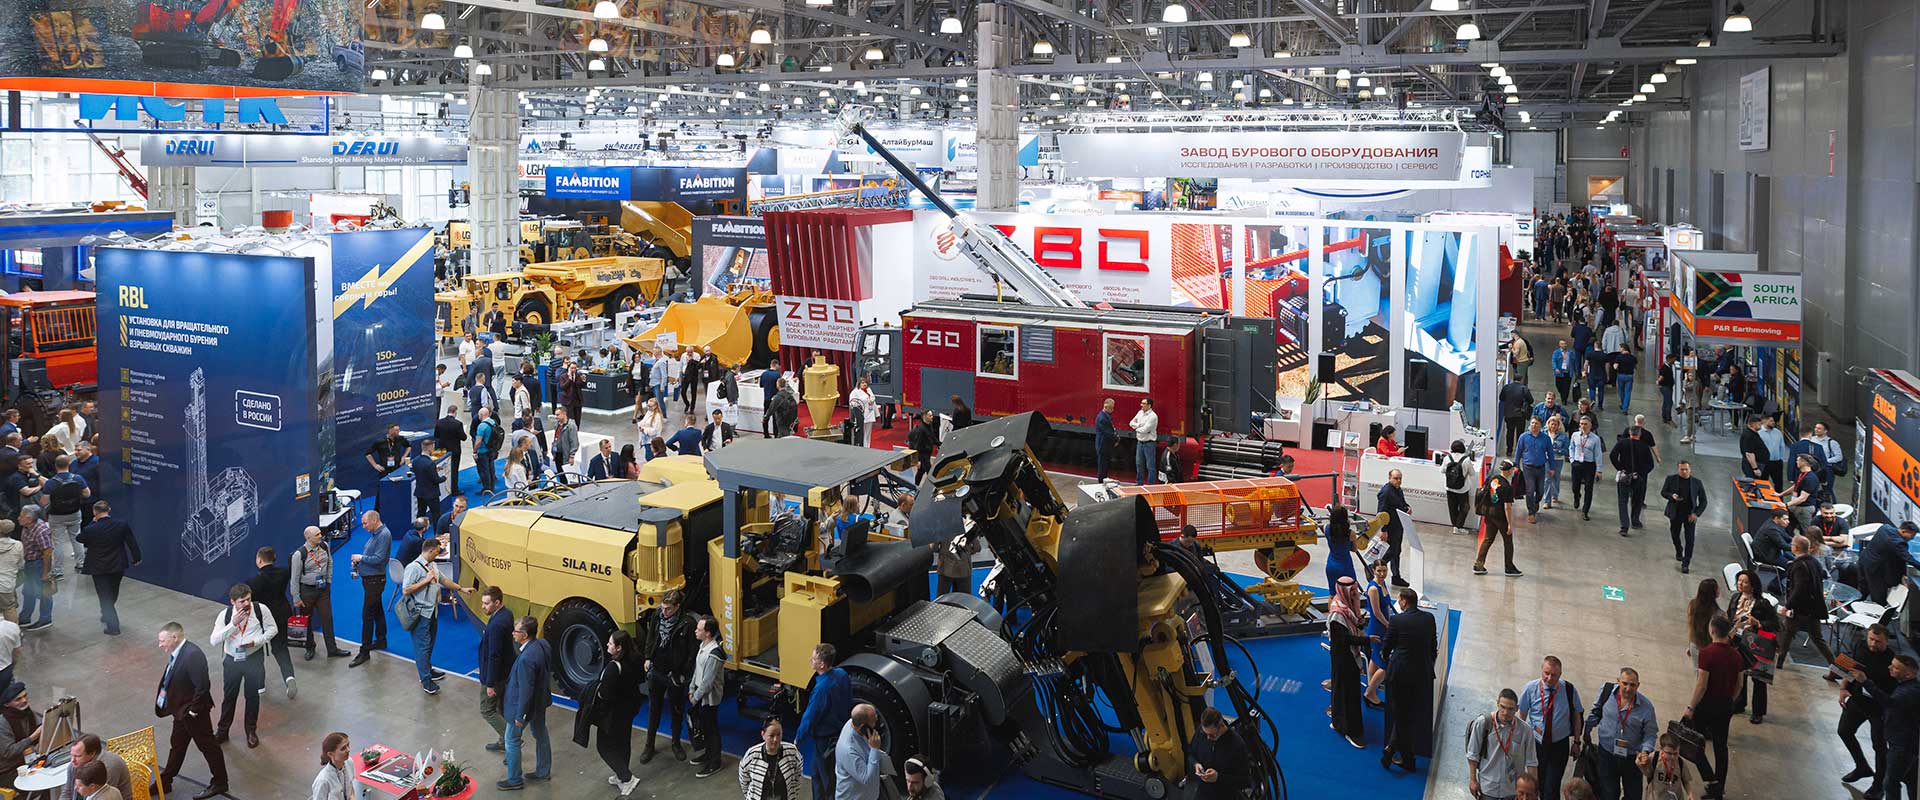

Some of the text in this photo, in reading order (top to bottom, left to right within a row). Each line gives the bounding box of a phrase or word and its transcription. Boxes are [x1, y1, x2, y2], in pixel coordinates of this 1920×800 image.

[165, 139, 216, 156] DERUI
[332, 141, 400, 156] DERUI
[881, 138, 934, 147] АлтайБурМаш
[1180, 147, 1439, 160] ЗАВОД БУРОВОГО ОБОРУДОВАНИЯ
[302, 156, 333, 165] Shandong
[352, 156, 373, 165] Mining
[374, 156, 403, 166] Machinery
[1180, 161, 1248, 170] ИССЛЕДОВАНИЯ
[1255, 162, 1312, 170] РАЗРАБОТКИ
[1320, 162, 1393, 170] ПРОИЗВОДСТВО
[556, 172, 620, 188] FAMBITION
[680, 173, 735, 189] FAMBITION
[341, 281, 376, 292] ВМЕСТЕ
[374, 287, 398, 299] горы!
[1753, 284, 1795, 294] SOUTH
[118, 285, 149, 309] RBL
[1753, 296, 1799, 305] AFRICA
[783, 301, 855, 324] ZBO
[128, 315, 229, 335] УСТАНОВКА ДЛЯ ВРАЩАТЕЛЬНОГО
[785, 321, 856, 332] НАДЕЖНЫЙ ПАРТНЕР
[1732, 325, 1782, 335] Earthmoving
[129, 328, 218, 347] И ПНЕВМОУДАРНОГО БУРЕНИЯ
[786, 335, 821, 343] БУРОВЫМИ
[815, 330, 856, 339] ЗАНИМАЕТСЯ
[909, 328, 960, 348] ZBO
[129, 339, 192, 356] ВЗРЫВНЫХ СКВАЖИН
[376, 350, 397, 361] 150+
[376, 388, 410, 402] 10000+
[242, 398, 272, 411] СДЕЛАНО
[242, 410, 273, 423] В РОССИИ
[562, 557, 612, 577] SILA RL6
[725, 594, 733, 652] SILA RL6
